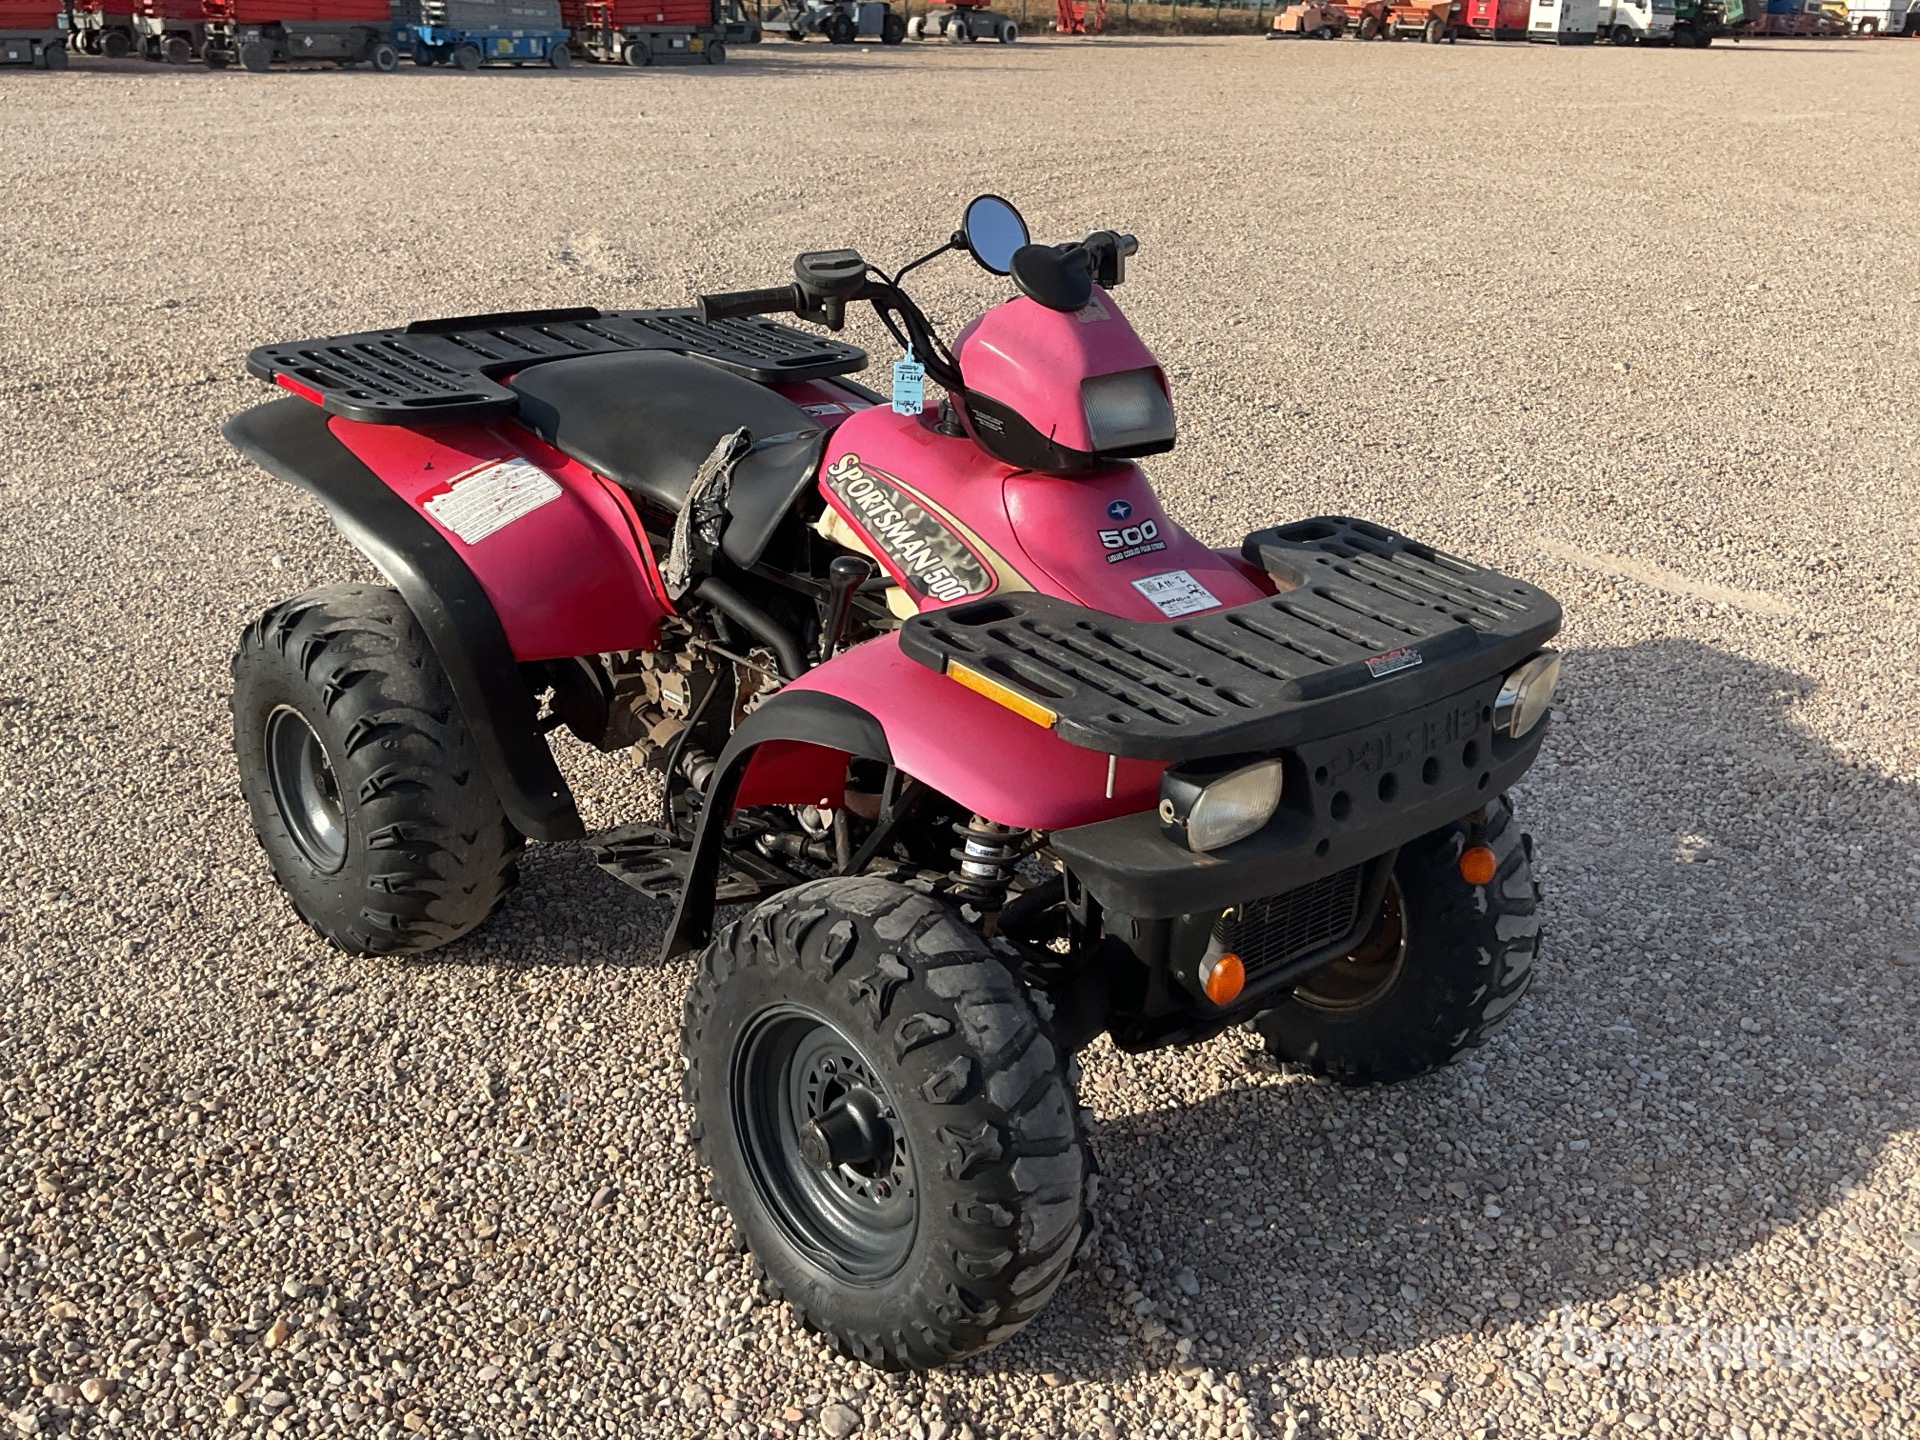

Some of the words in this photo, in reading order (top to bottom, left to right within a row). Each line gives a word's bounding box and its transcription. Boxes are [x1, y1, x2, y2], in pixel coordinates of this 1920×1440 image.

[828, 453, 944, 572] SPORTSMAN
[922, 566, 969, 602] 500
[1098, 518, 1159, 550] 500
